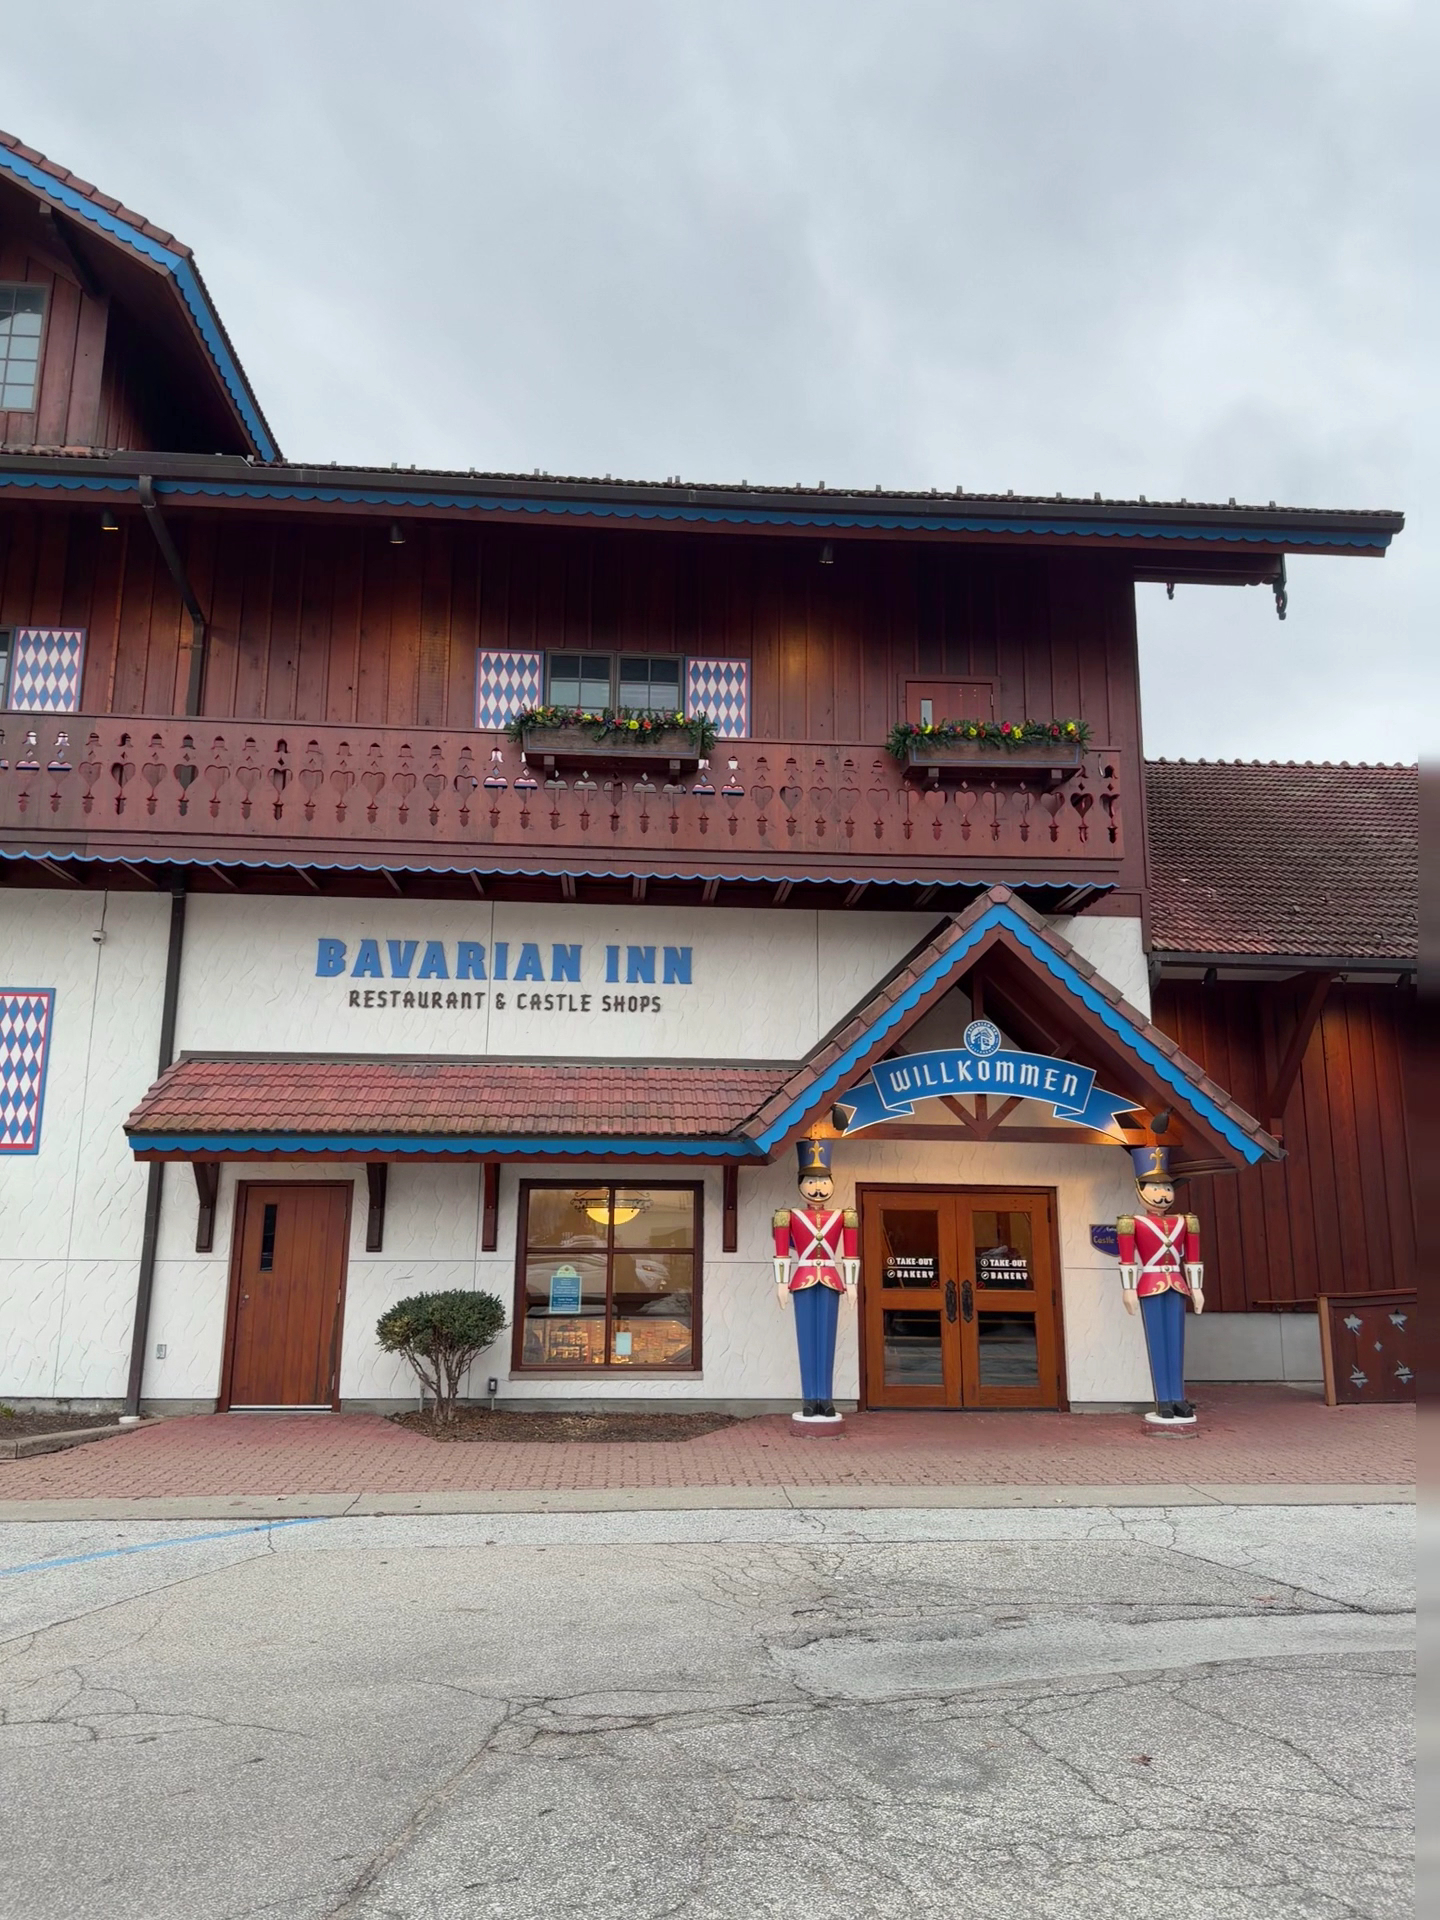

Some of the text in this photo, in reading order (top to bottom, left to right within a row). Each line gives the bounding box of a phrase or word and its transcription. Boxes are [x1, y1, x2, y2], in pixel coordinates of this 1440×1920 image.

[315, 938, 693, 985] BAVARIAN INN
[348, 989, 662, 1014] RESTAURANT & CASTLE SHOPS
[888, 1058, 1079, 1097] WILLKOMMEN
[895, 1257, 934, 1266] TAKE-OUT
[989, 1259, 1027, 1268] TAKE-OUT
[896, 1270, 934, 1279] BAKERY
[990, 1271, 1028, 1280] BAKERY
